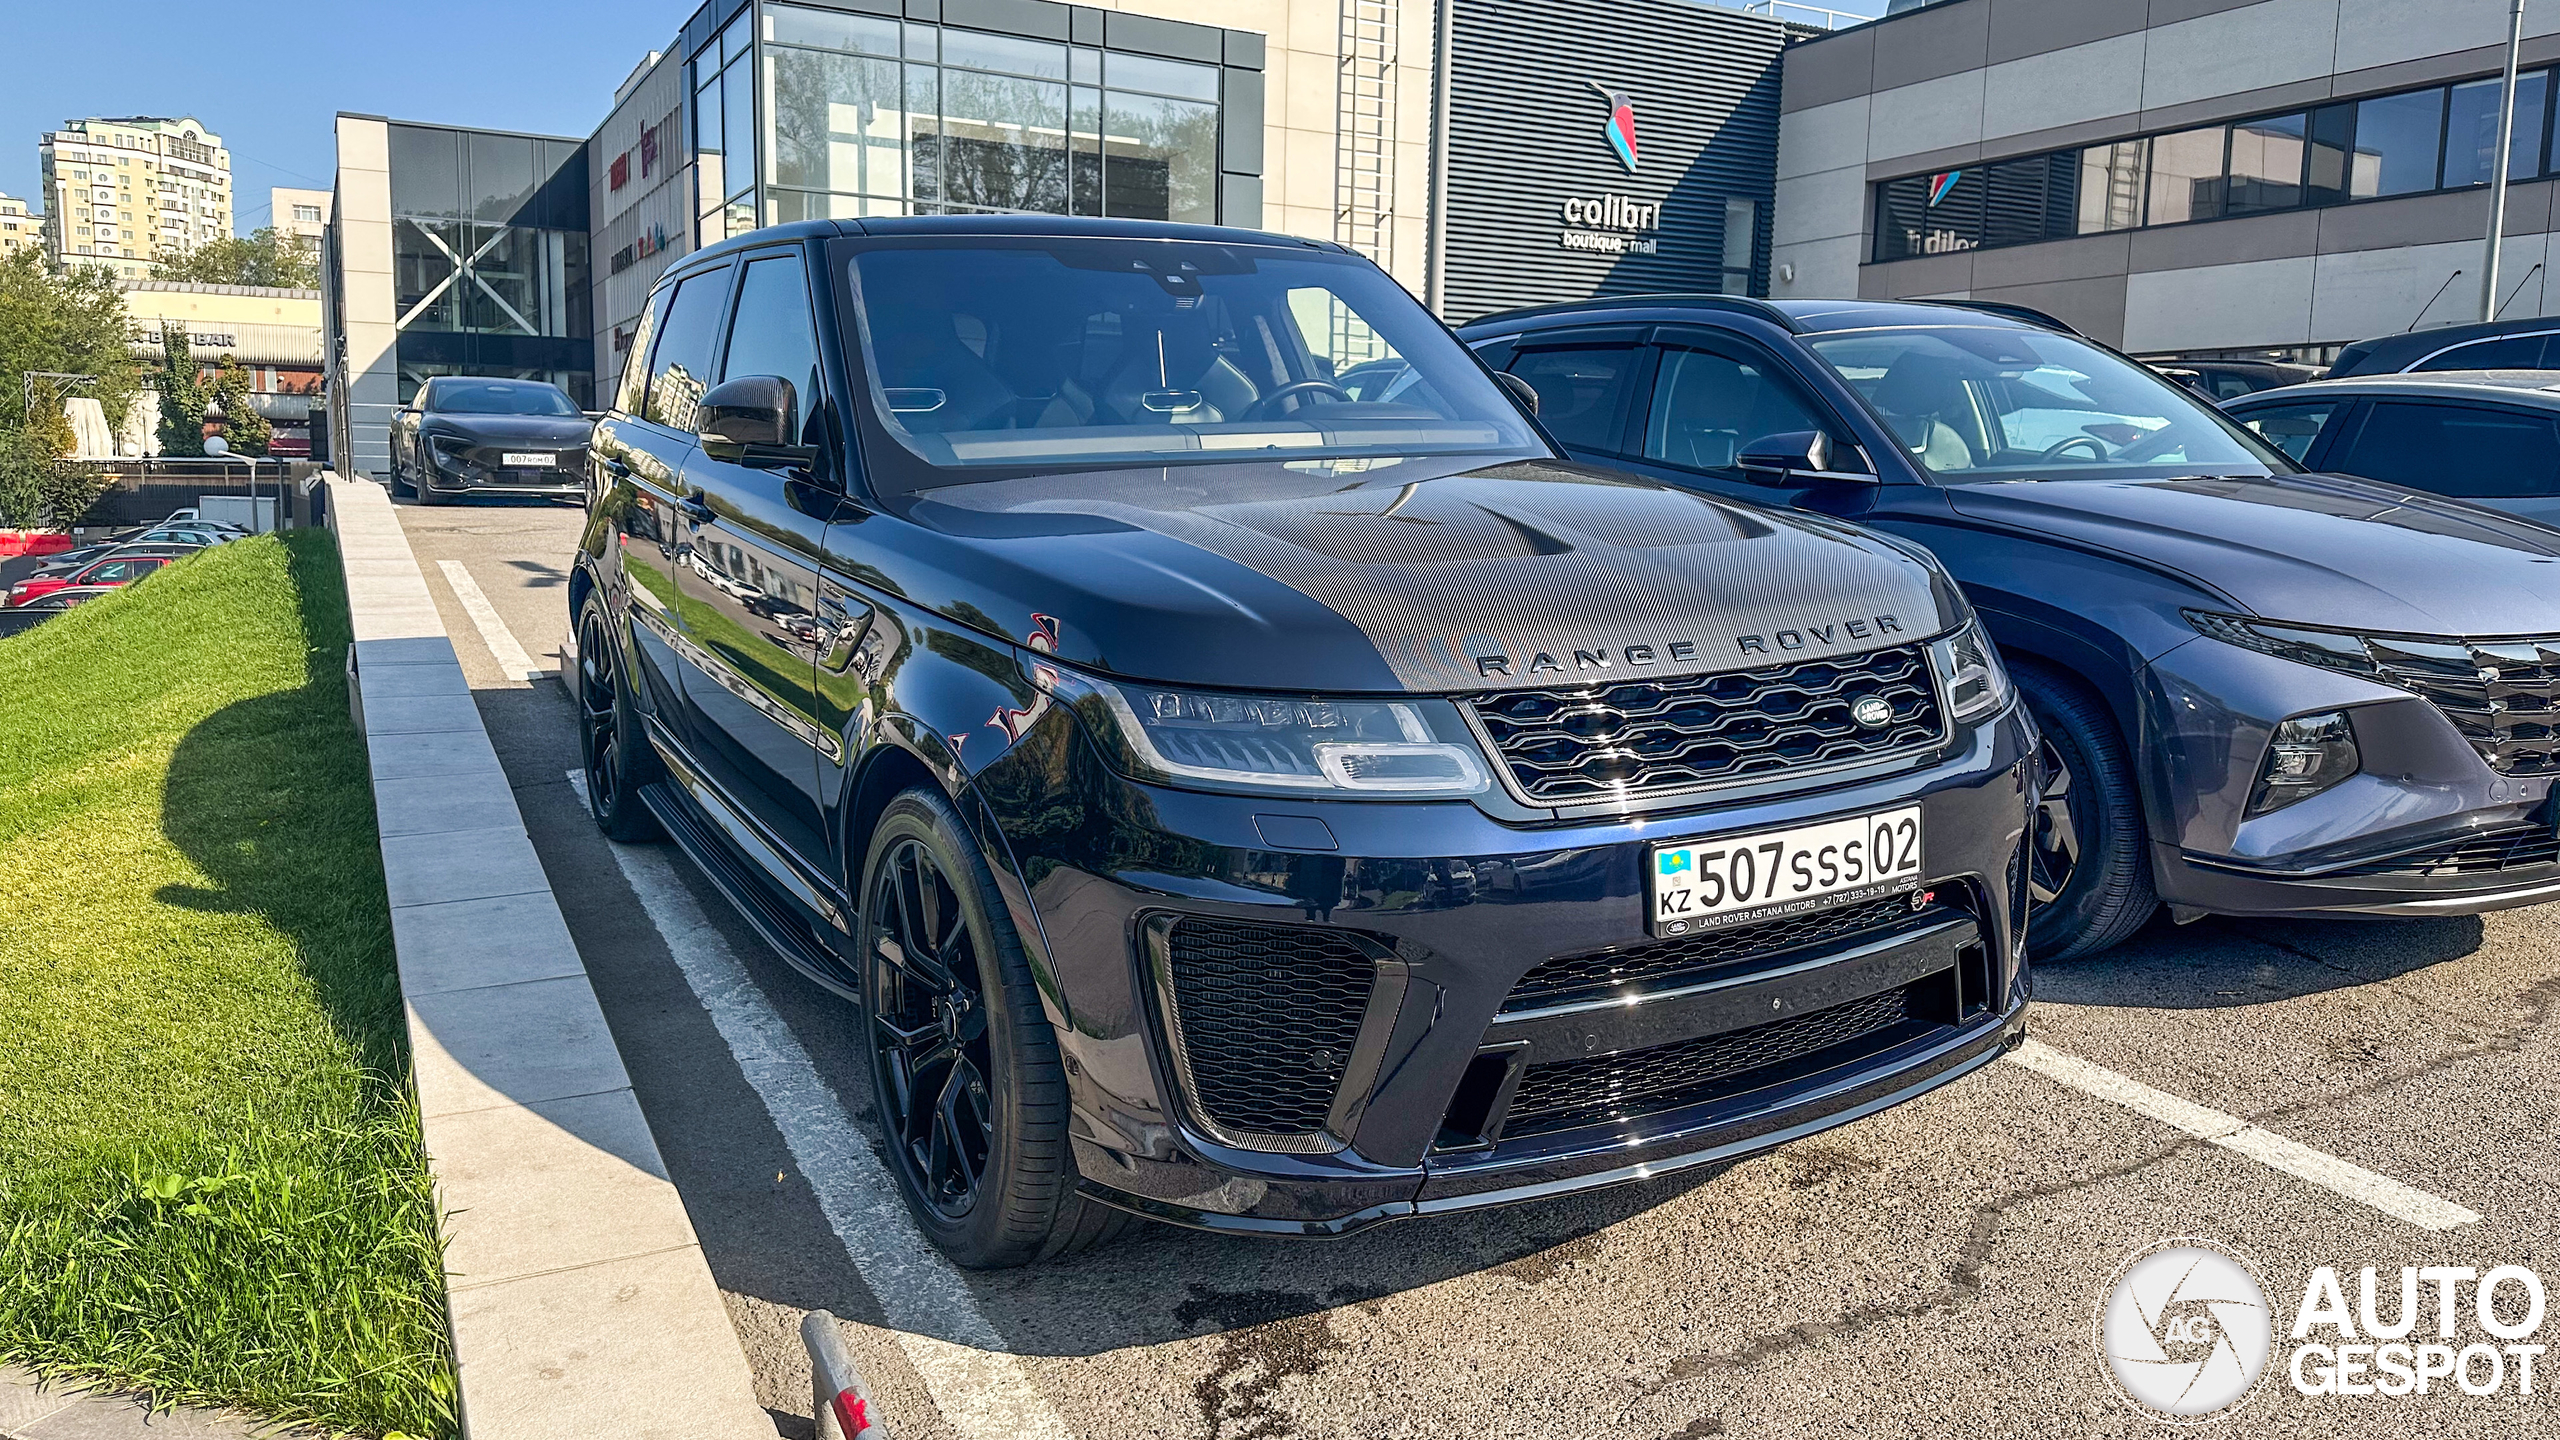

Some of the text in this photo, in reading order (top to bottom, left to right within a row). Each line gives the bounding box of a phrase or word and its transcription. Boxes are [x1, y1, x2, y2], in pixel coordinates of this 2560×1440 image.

[1564, 193, 1661, 230] colibri
[1563, 230, 1658, 254] boutique mall
[194, 333, 236, 347] BAR
[1478, 613, 1901, 677] RANGE ROVER
[1891, 881, 1918, 894] MOTORS
[1660, 888, 1692, 915] KZ
[1697, 885, 1886, 928] LAND ROVER ASTANA MOTORS +7 (727) 333-19-19
